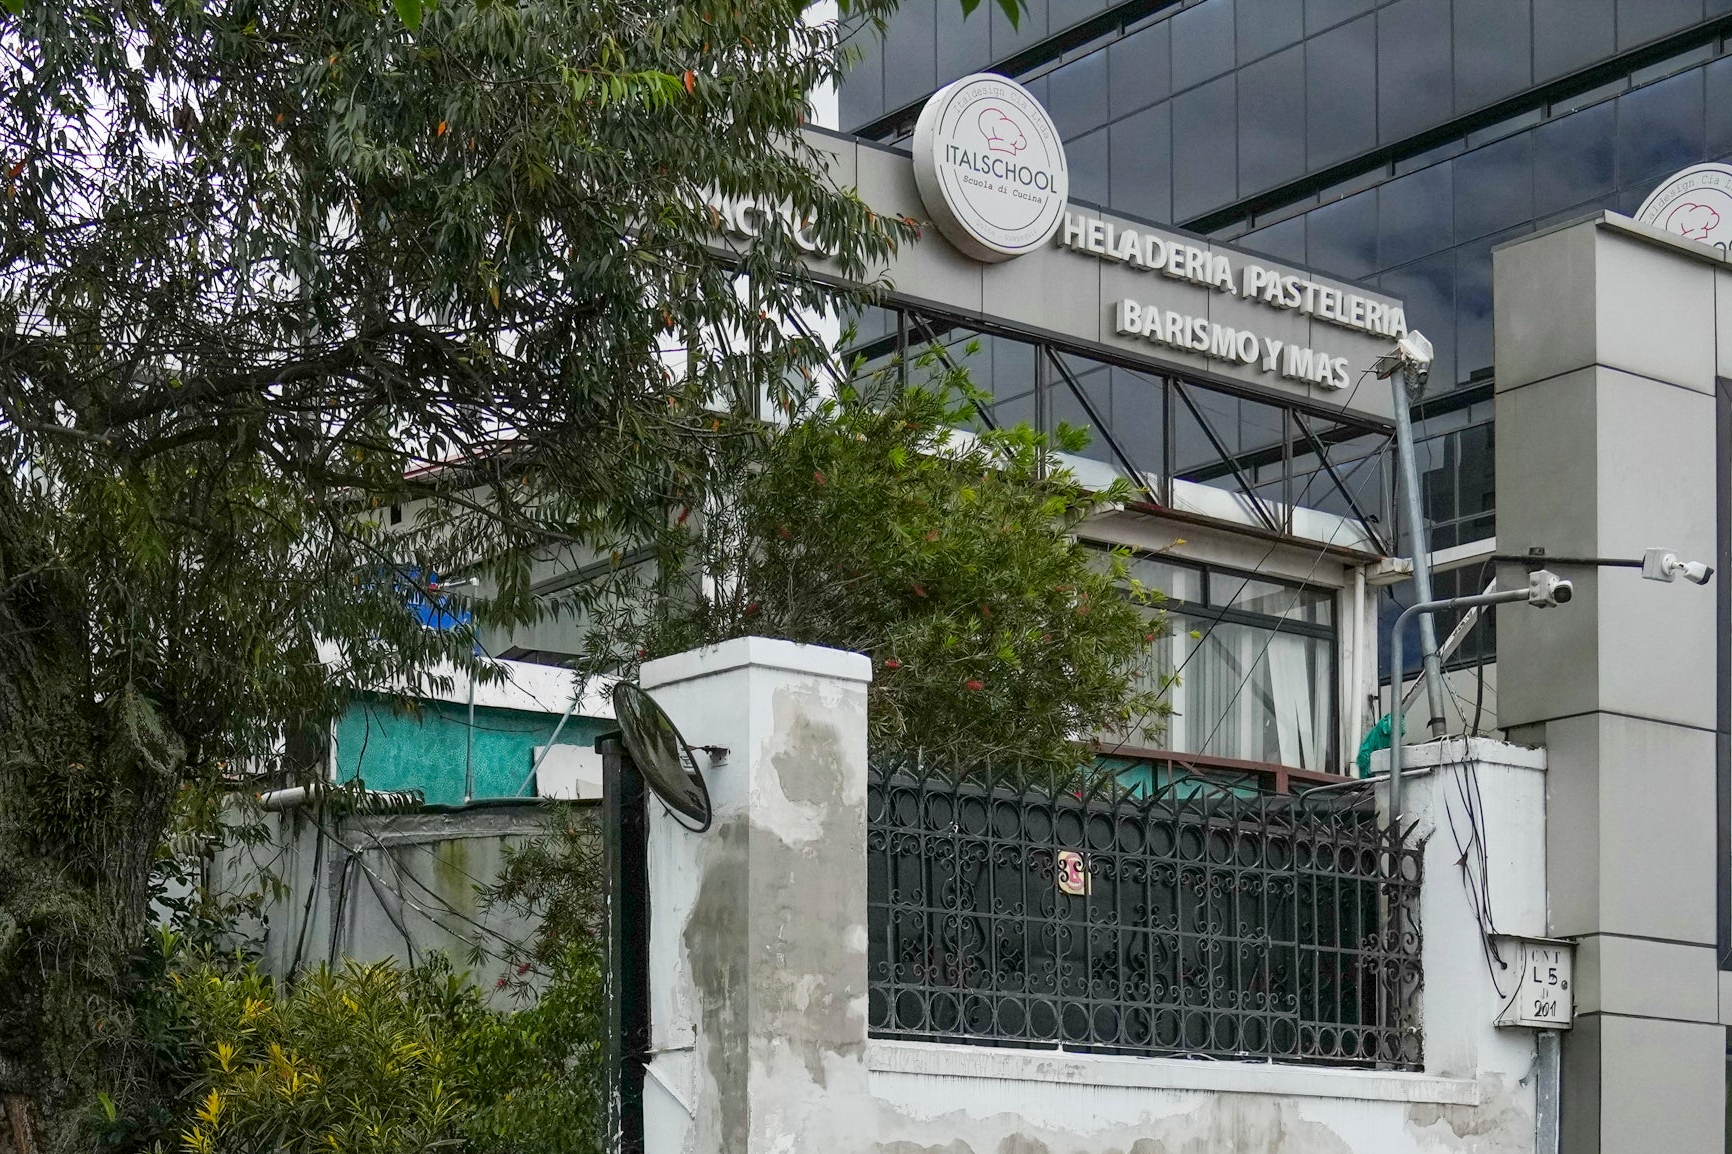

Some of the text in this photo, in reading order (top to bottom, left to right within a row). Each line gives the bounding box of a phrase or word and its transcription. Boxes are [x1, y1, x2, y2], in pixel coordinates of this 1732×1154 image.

[952, 85, 1006, 114] Italdesign
[945, 144, 1057, 194] ITALSCHOOL
[963, 175, 1043, 204] Scuola di Cucina
[1641, 180, 1695, 223] aldesign
[1243, 264, 1408, 340] PASTELERIA
[1118, 299, 1350, 391] BARISMO Y MAS
[1533, 966, 1558, 986] L 5
[1533, 999, 1557, 1017] 201
